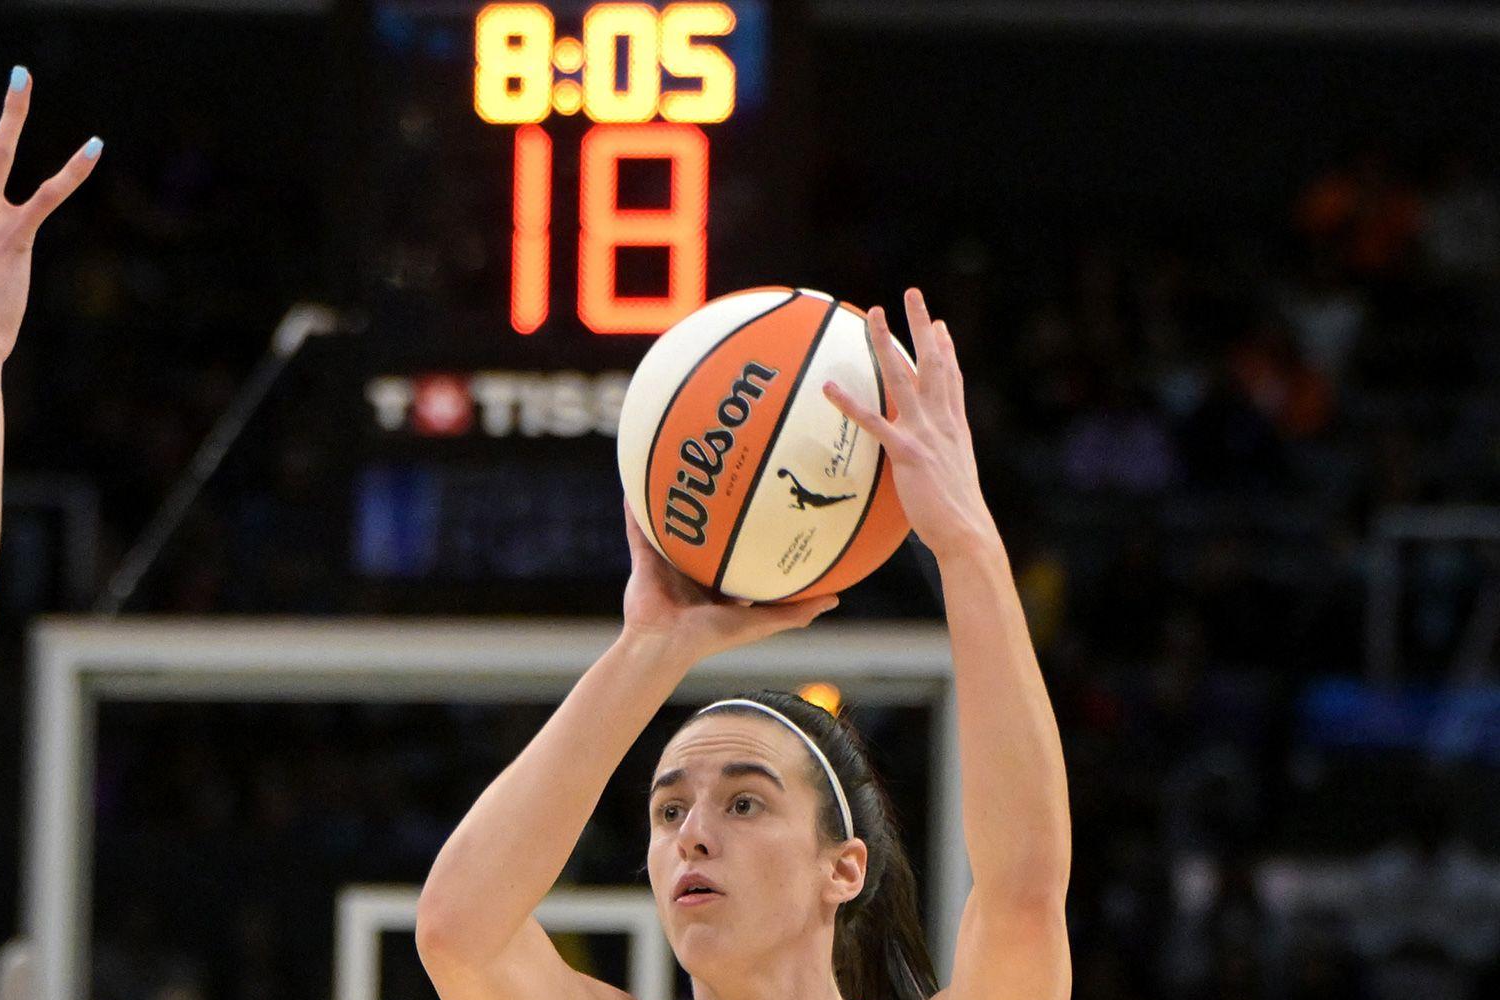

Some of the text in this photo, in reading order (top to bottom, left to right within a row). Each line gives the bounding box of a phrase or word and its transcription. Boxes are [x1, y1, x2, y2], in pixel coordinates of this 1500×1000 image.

[474, 2, 736, 124] 8:05
[510, 123, 710, 335] 18
[663, 360, 780, 546] Wilson
